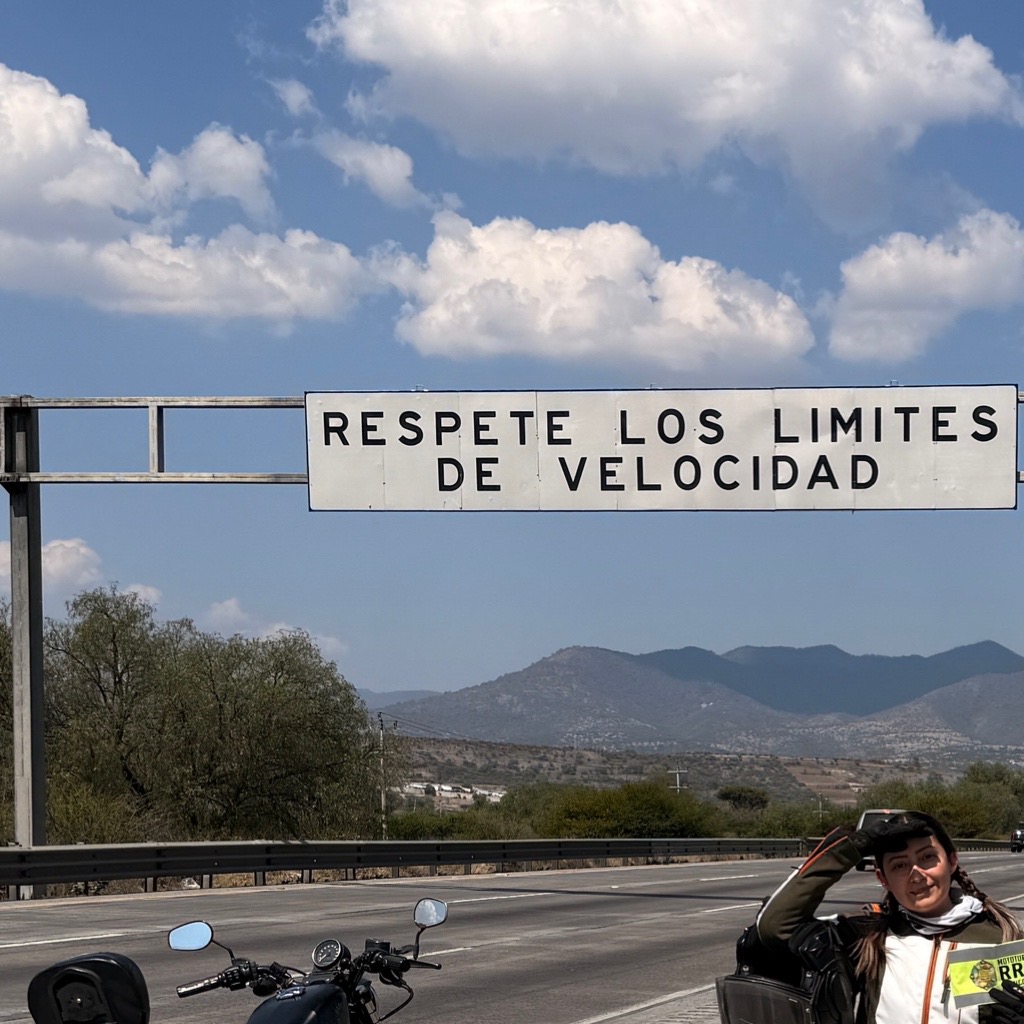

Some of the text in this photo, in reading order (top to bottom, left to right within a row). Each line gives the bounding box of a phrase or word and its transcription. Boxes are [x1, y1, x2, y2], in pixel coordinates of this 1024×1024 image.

[324, 406, 997, 446] RESPETE LOS LIMITES
[438, 455, 878, 491] DE VELOCIDAD
